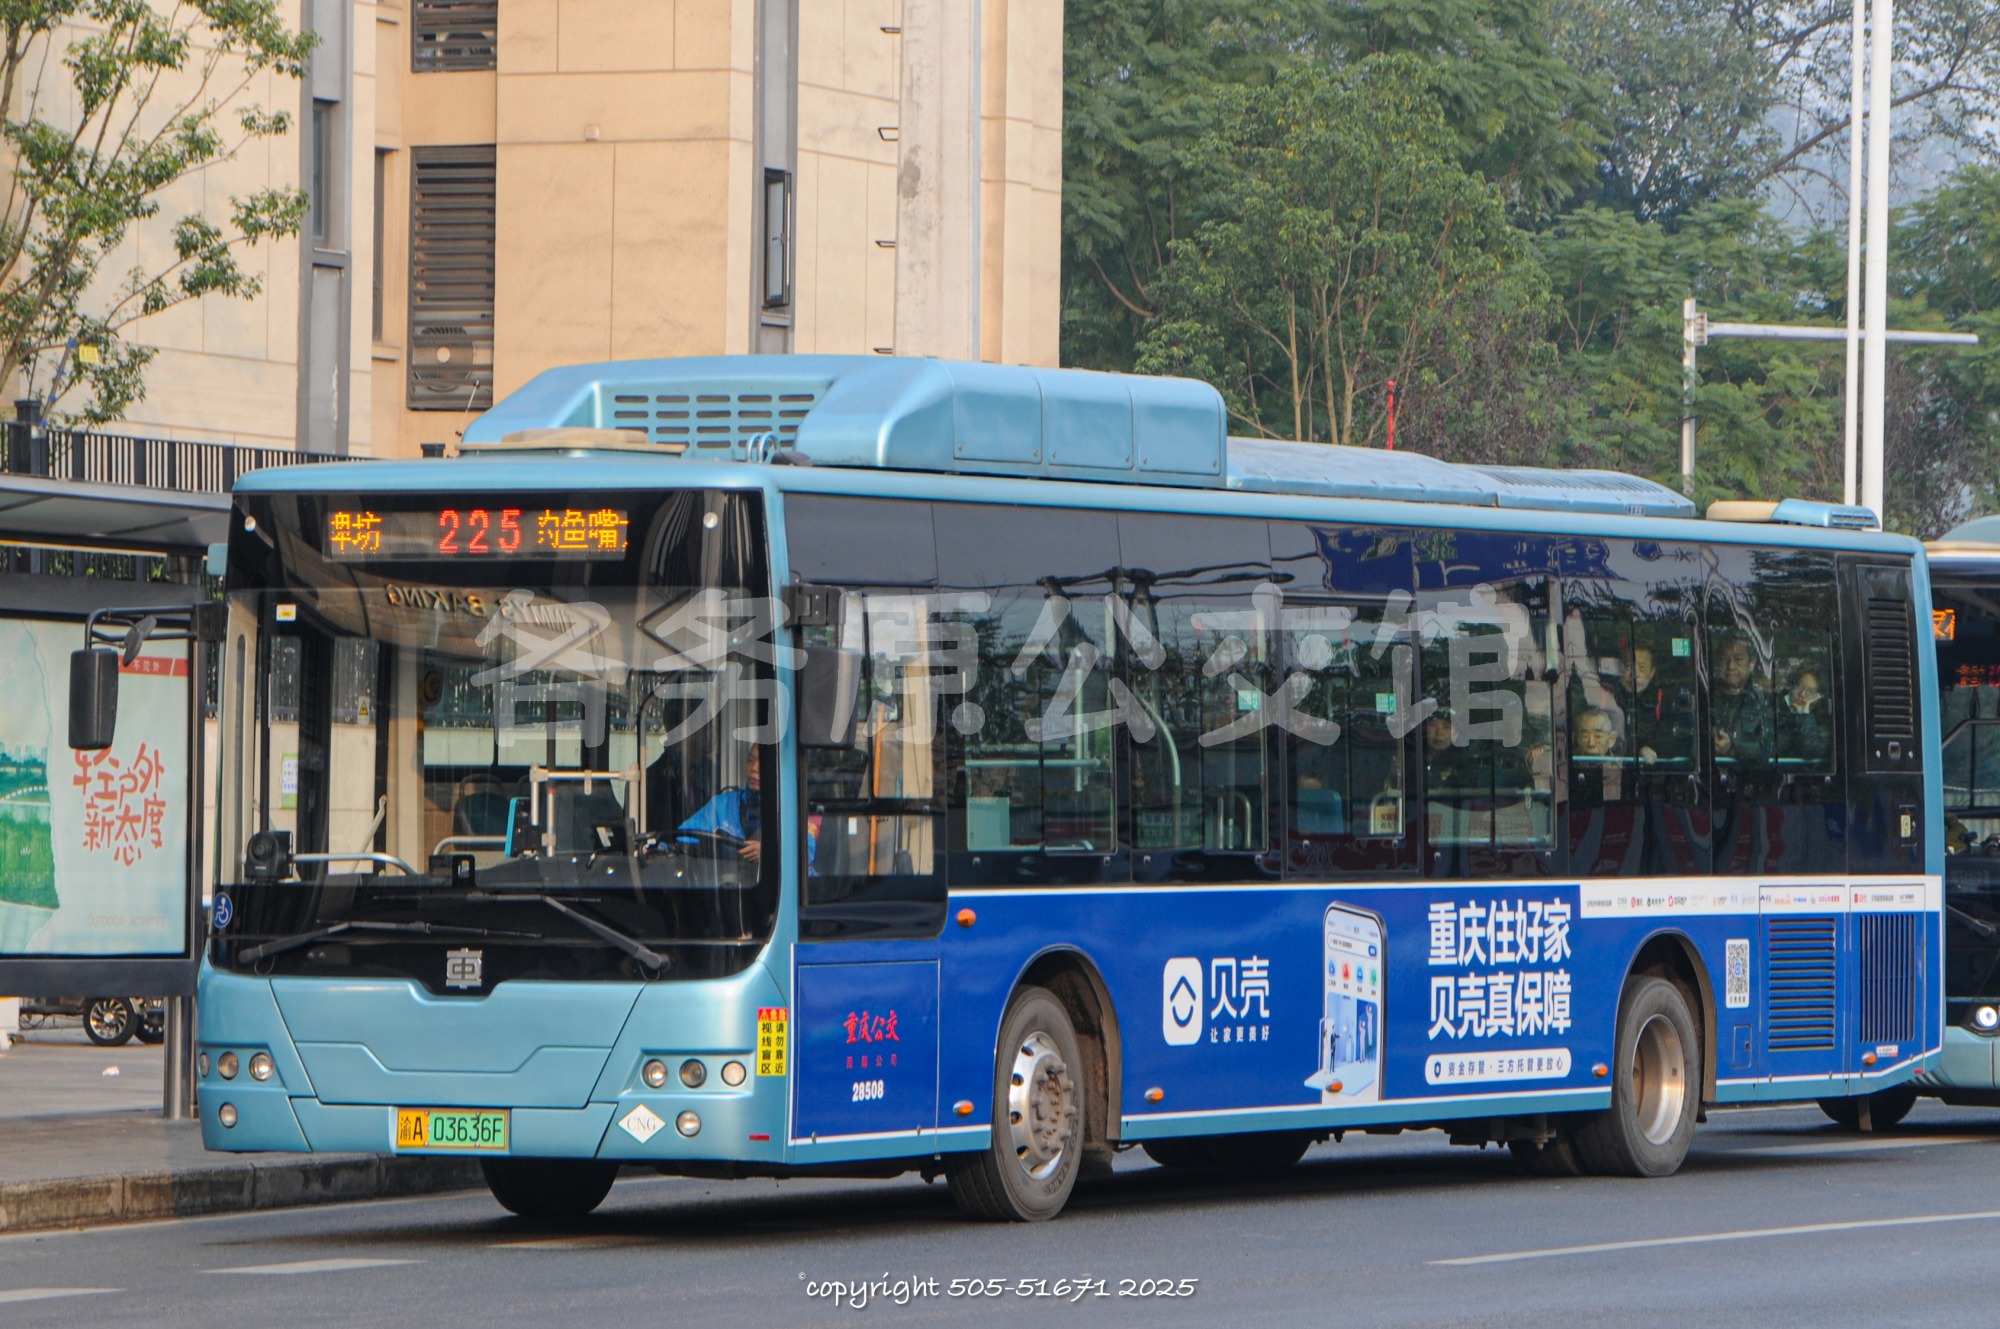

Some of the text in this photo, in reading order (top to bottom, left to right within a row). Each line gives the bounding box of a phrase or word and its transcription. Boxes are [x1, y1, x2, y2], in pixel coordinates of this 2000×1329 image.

[439, 509, 521, 553] 225
[538, 509, 629, 553] 钓鱼嘴
[82, 792, 166, 866] 新态度
[1428, 897, 1572, 967] 重庆住好家
[1210, 954, 1270, 1020] 贝壳
[1428, 968, 1572, 1041] 贝壳真保障
[761, 1022, 772, 1074] 视线盲区
[775, 1022, 784, 1074] 请勿靠近
[843, 1009, 900, 1045] 重庆公交
[1210, 1025, 1270, 1043] 让家更美好
[852, 1079, 884, 1102] 28508
[433, 1116, 503, 1142] 03636F
[626, 1116, 656, 1131] CNG
